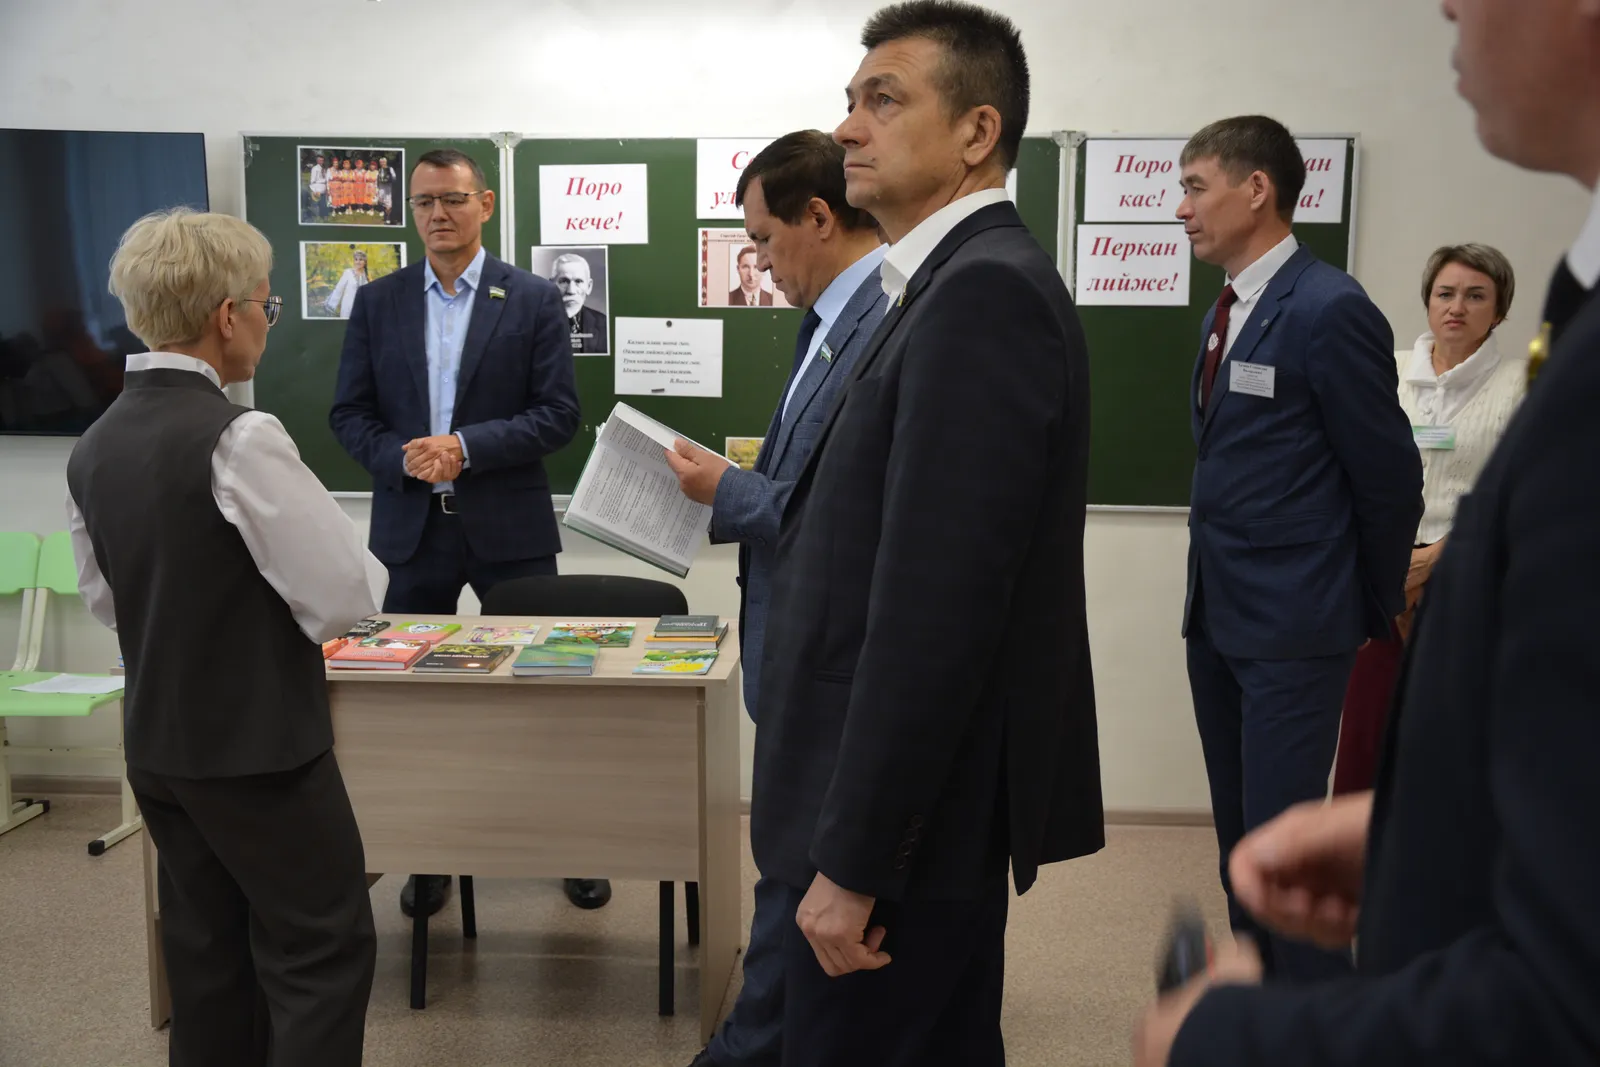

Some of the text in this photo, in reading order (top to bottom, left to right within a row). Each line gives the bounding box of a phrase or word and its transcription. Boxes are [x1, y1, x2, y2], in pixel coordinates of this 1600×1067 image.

[1114, 154, 1173, 178] Поро
[1304, 157, 1332, 172] ан
[565, 176, 623, 201] Поро
[1119, 188, 1166, 208] кас!
[1298, 188, 1325, 208] а!
[565, 211, 623, 231] кече!
[1090, 236, 1178, 262] Перкан
[1086, 272, 1179, 293] лийже!
